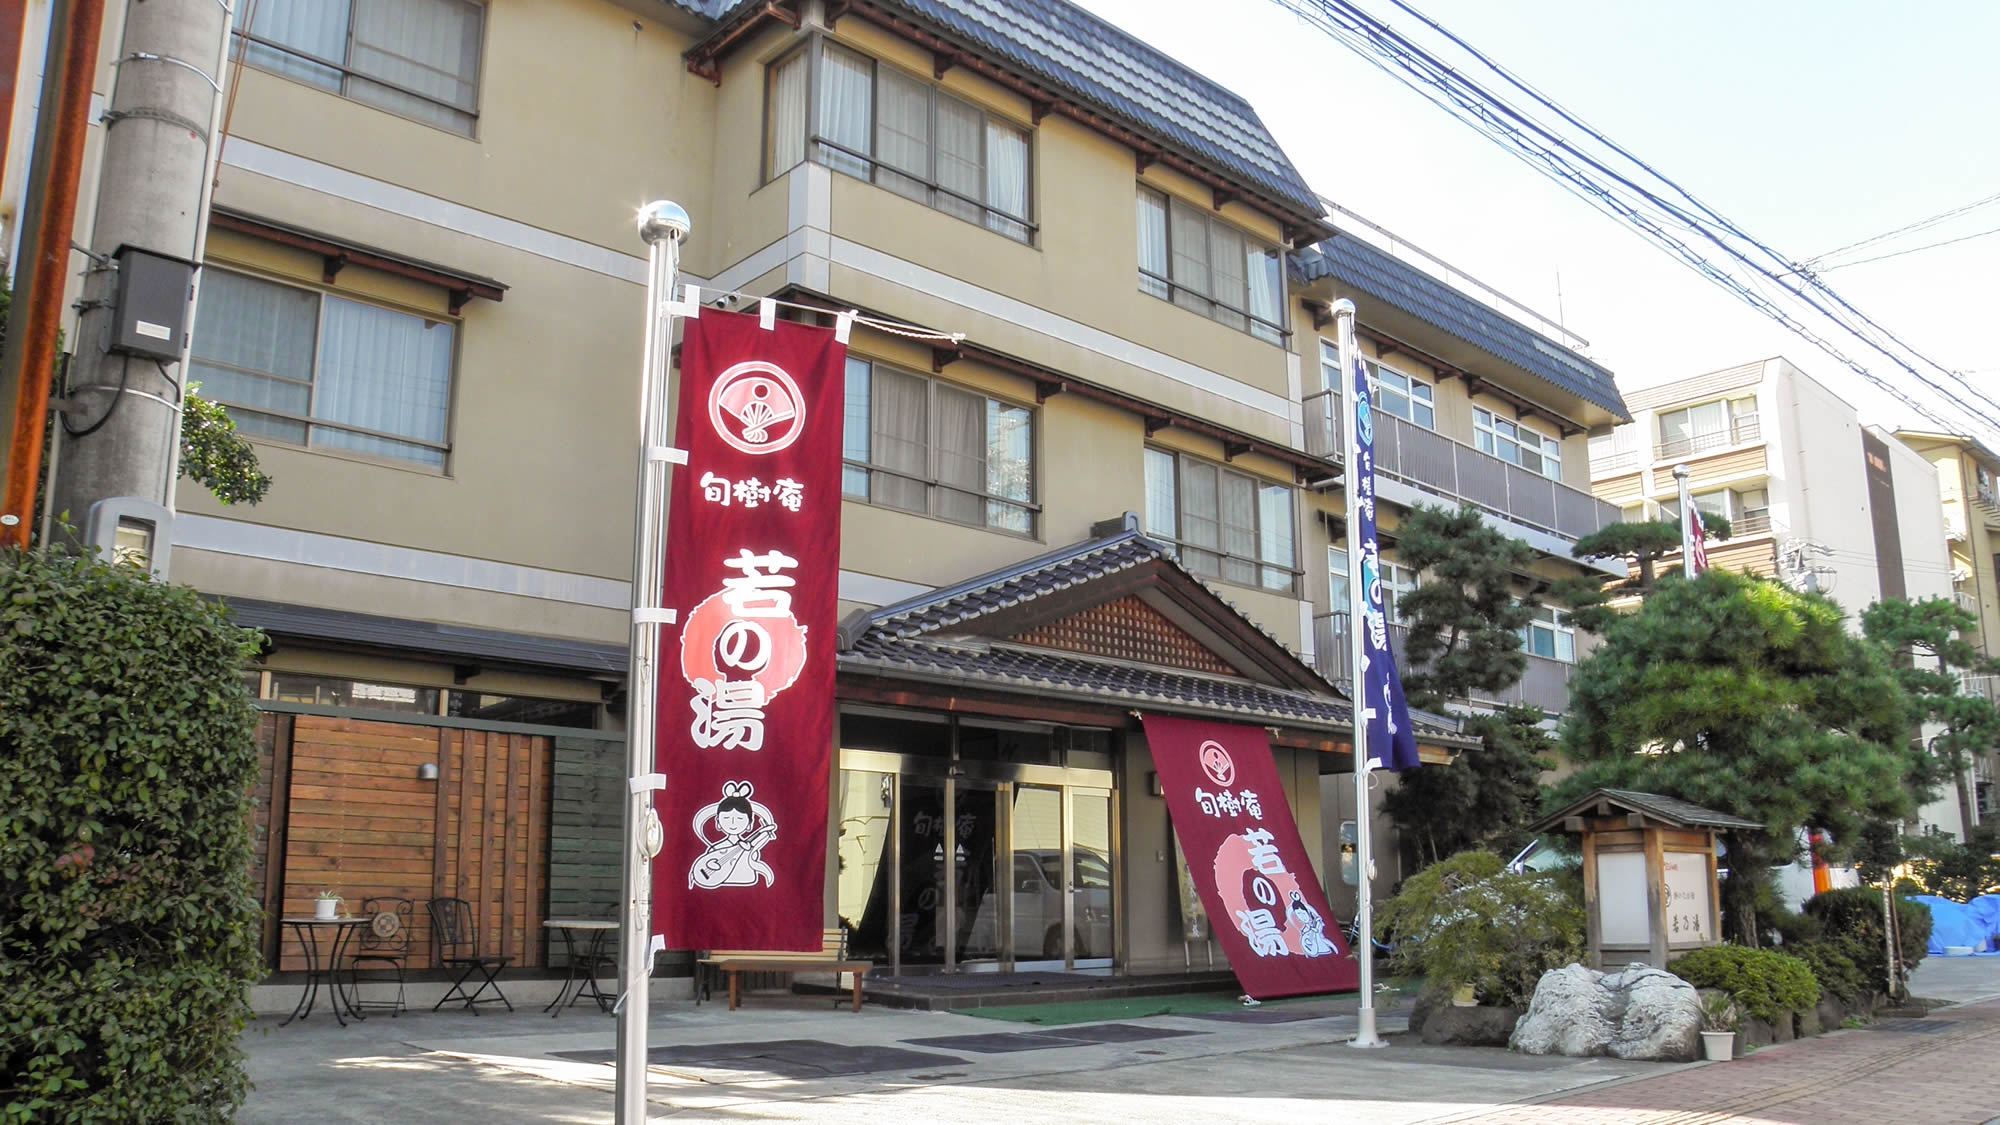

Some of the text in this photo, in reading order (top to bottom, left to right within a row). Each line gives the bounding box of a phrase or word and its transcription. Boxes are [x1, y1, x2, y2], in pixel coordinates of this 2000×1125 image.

[700, 472, 804, 512] 旬樹庵
[690, 549, 799, 751] 若の湯
[1195, 787, 1263, 820] 旬樹庵
[1236, 827, 1289, 957] 若の湯
